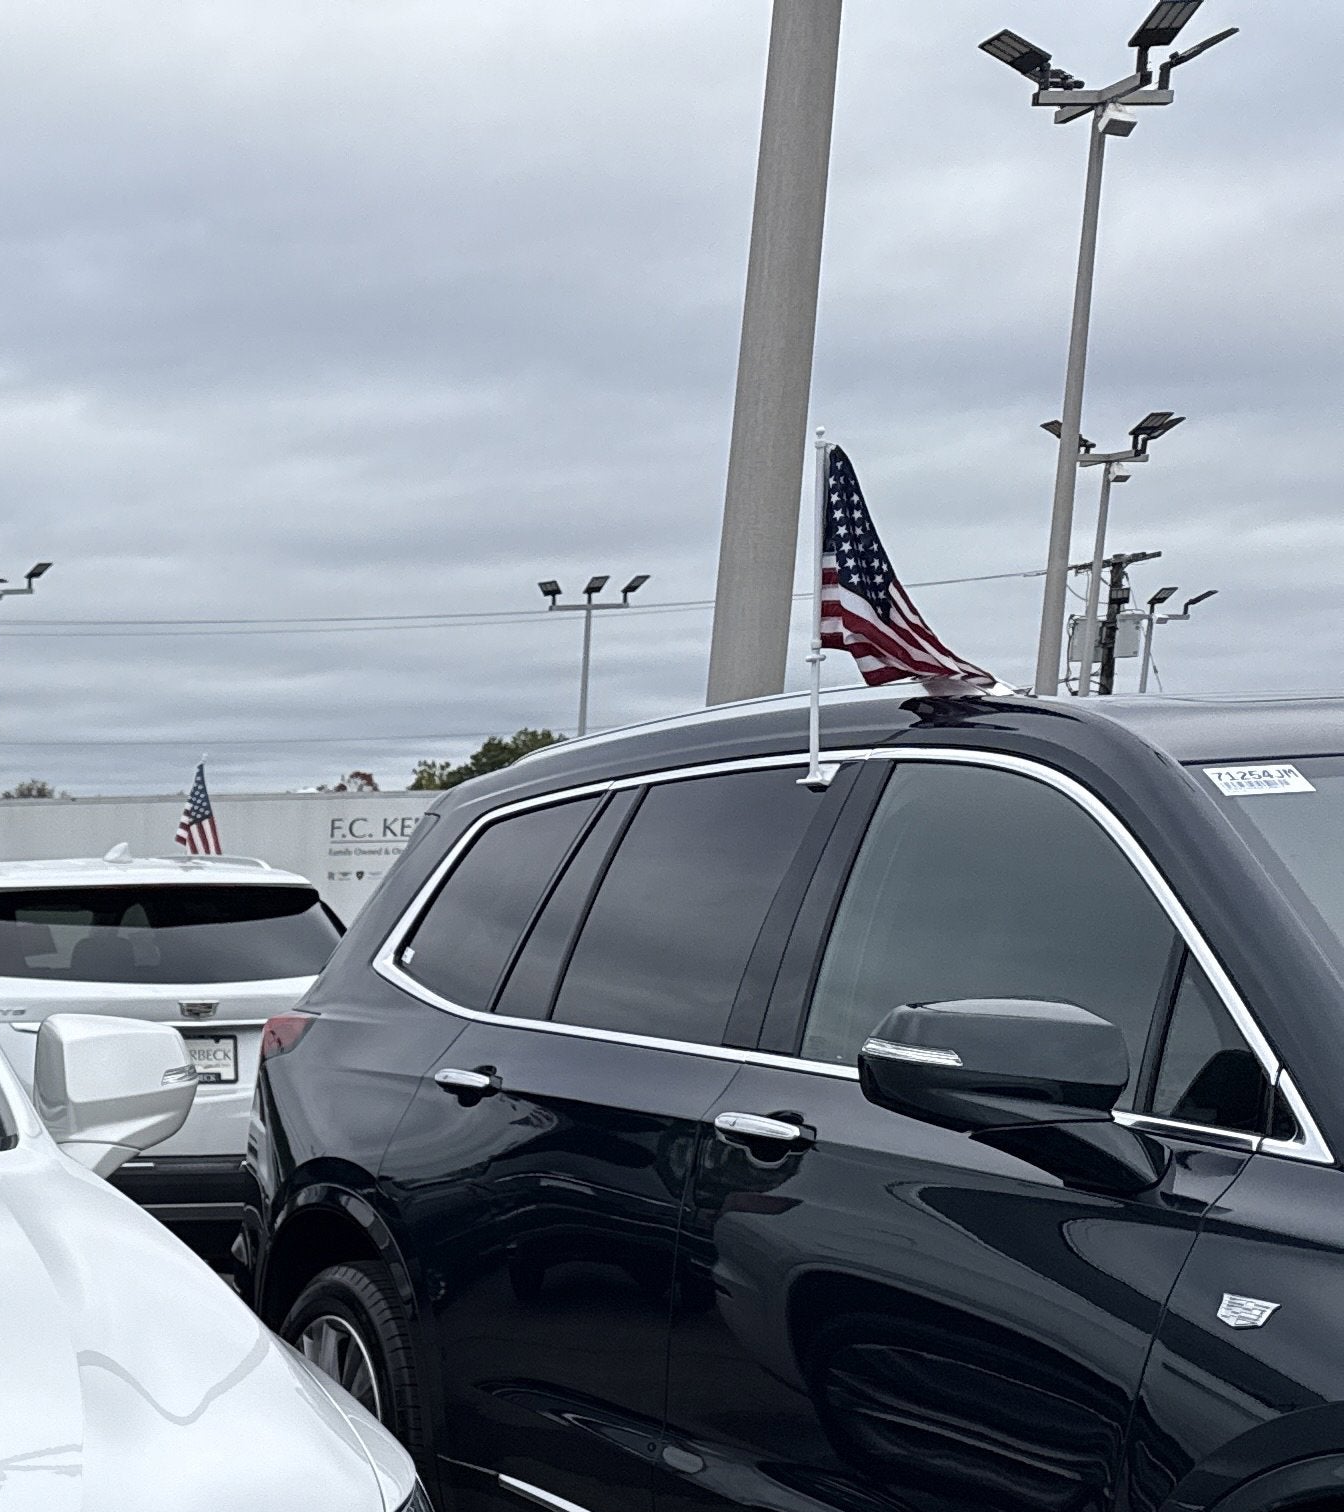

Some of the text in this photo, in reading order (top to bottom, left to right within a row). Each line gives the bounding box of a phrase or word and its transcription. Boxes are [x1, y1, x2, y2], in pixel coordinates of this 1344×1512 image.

[1212, 769, 1299, 781] 71254JM
[330, 817, 420, 839] F.C. KE
